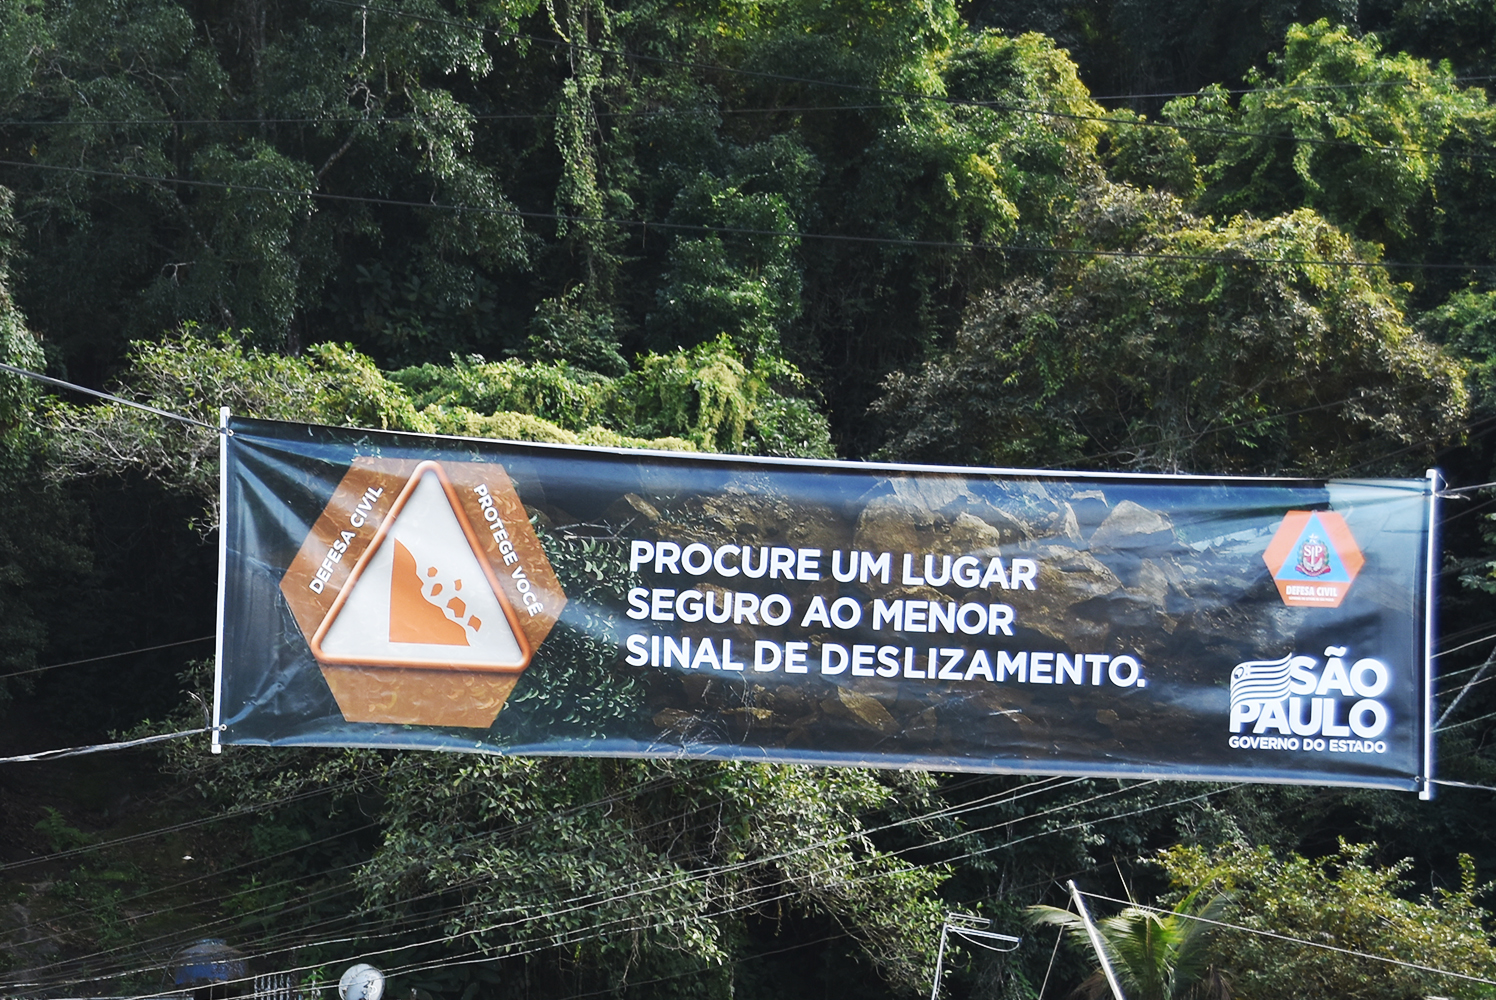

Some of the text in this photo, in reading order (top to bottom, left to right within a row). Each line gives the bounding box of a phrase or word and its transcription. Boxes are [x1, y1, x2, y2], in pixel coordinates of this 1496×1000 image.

[309, 485, 384, 594] DEFESA CIVIL
[473, 484, 544, 617] PROTEGE VOCÊ
[630, 540, 1037, 591] PROCURE UM LUGAR
[1285, 585, 1338, 597] DEFESA CIVIL
[625, 587, 1014, 636] SEGURO AO MENOR
[625, 634, 1146, 688] SINAL DE DESLIZAMENTO.
[1289, 645, 1389, 698] SÃO
[1229, 697, 1388, 739] PAULO
[1228, 735, 1387, 754] GOVERNO DO ESTADO
